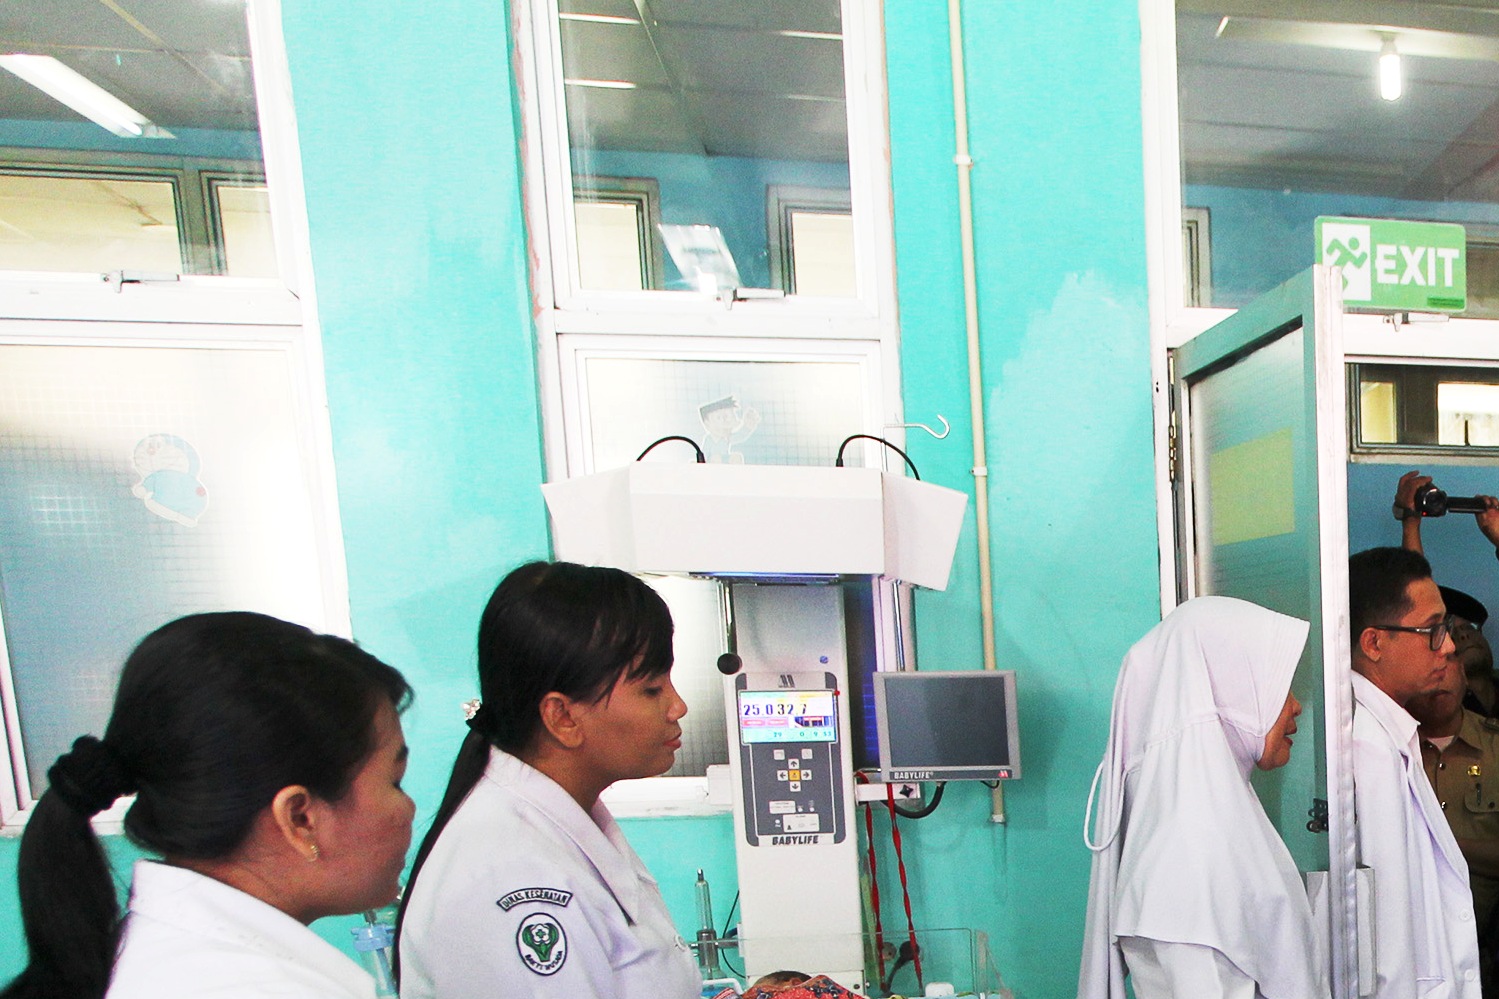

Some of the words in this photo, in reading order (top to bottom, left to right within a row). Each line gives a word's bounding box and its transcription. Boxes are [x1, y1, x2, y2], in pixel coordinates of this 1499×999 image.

[1375, 244, 1460, 287] EXIT
[743, 703, 773, 716] 25.0
[893, 771, 931, 780] BABYLIFE
[772, 835, 819, 845] BABYLIFE
[502, 892, 525, 908] DINAS
[525, 889, 569, 904] KESEHATAN
